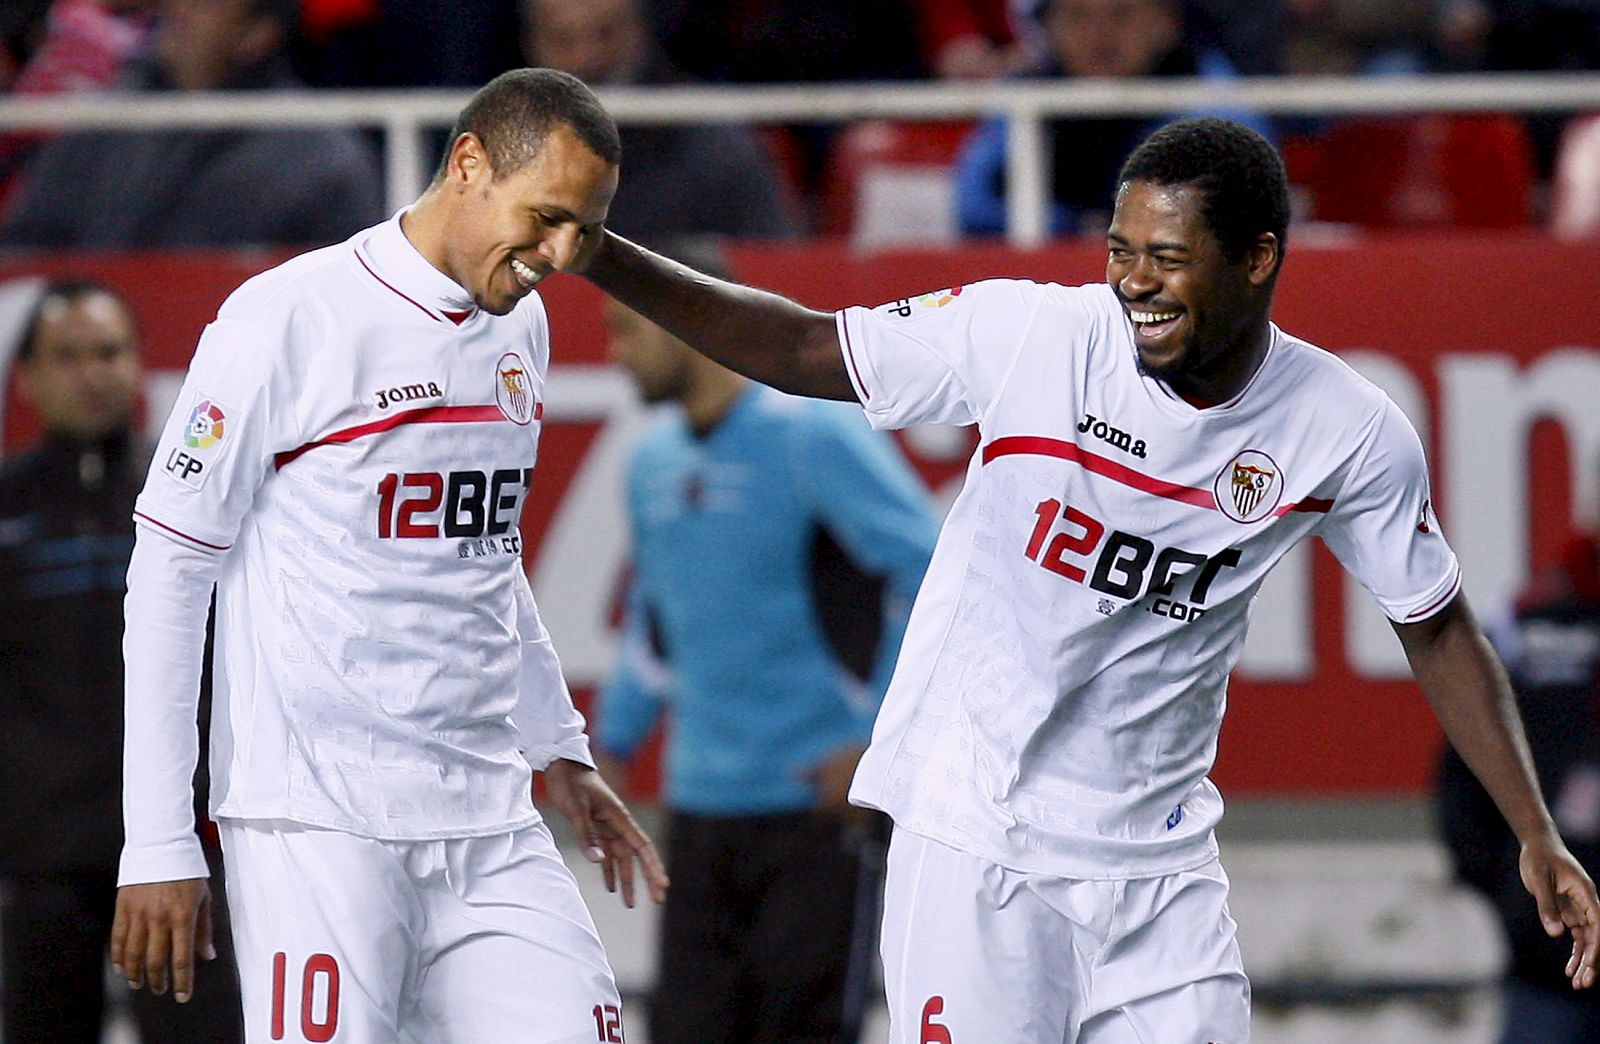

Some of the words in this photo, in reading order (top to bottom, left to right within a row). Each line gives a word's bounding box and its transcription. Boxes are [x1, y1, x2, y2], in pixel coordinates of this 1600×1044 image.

[166, 447, 204, 479] LFP
[1077, 414, 1147, 458] Joma
[1024, 498, 1242, 604] 12BET
[271, 951, 340, 1042] 10
